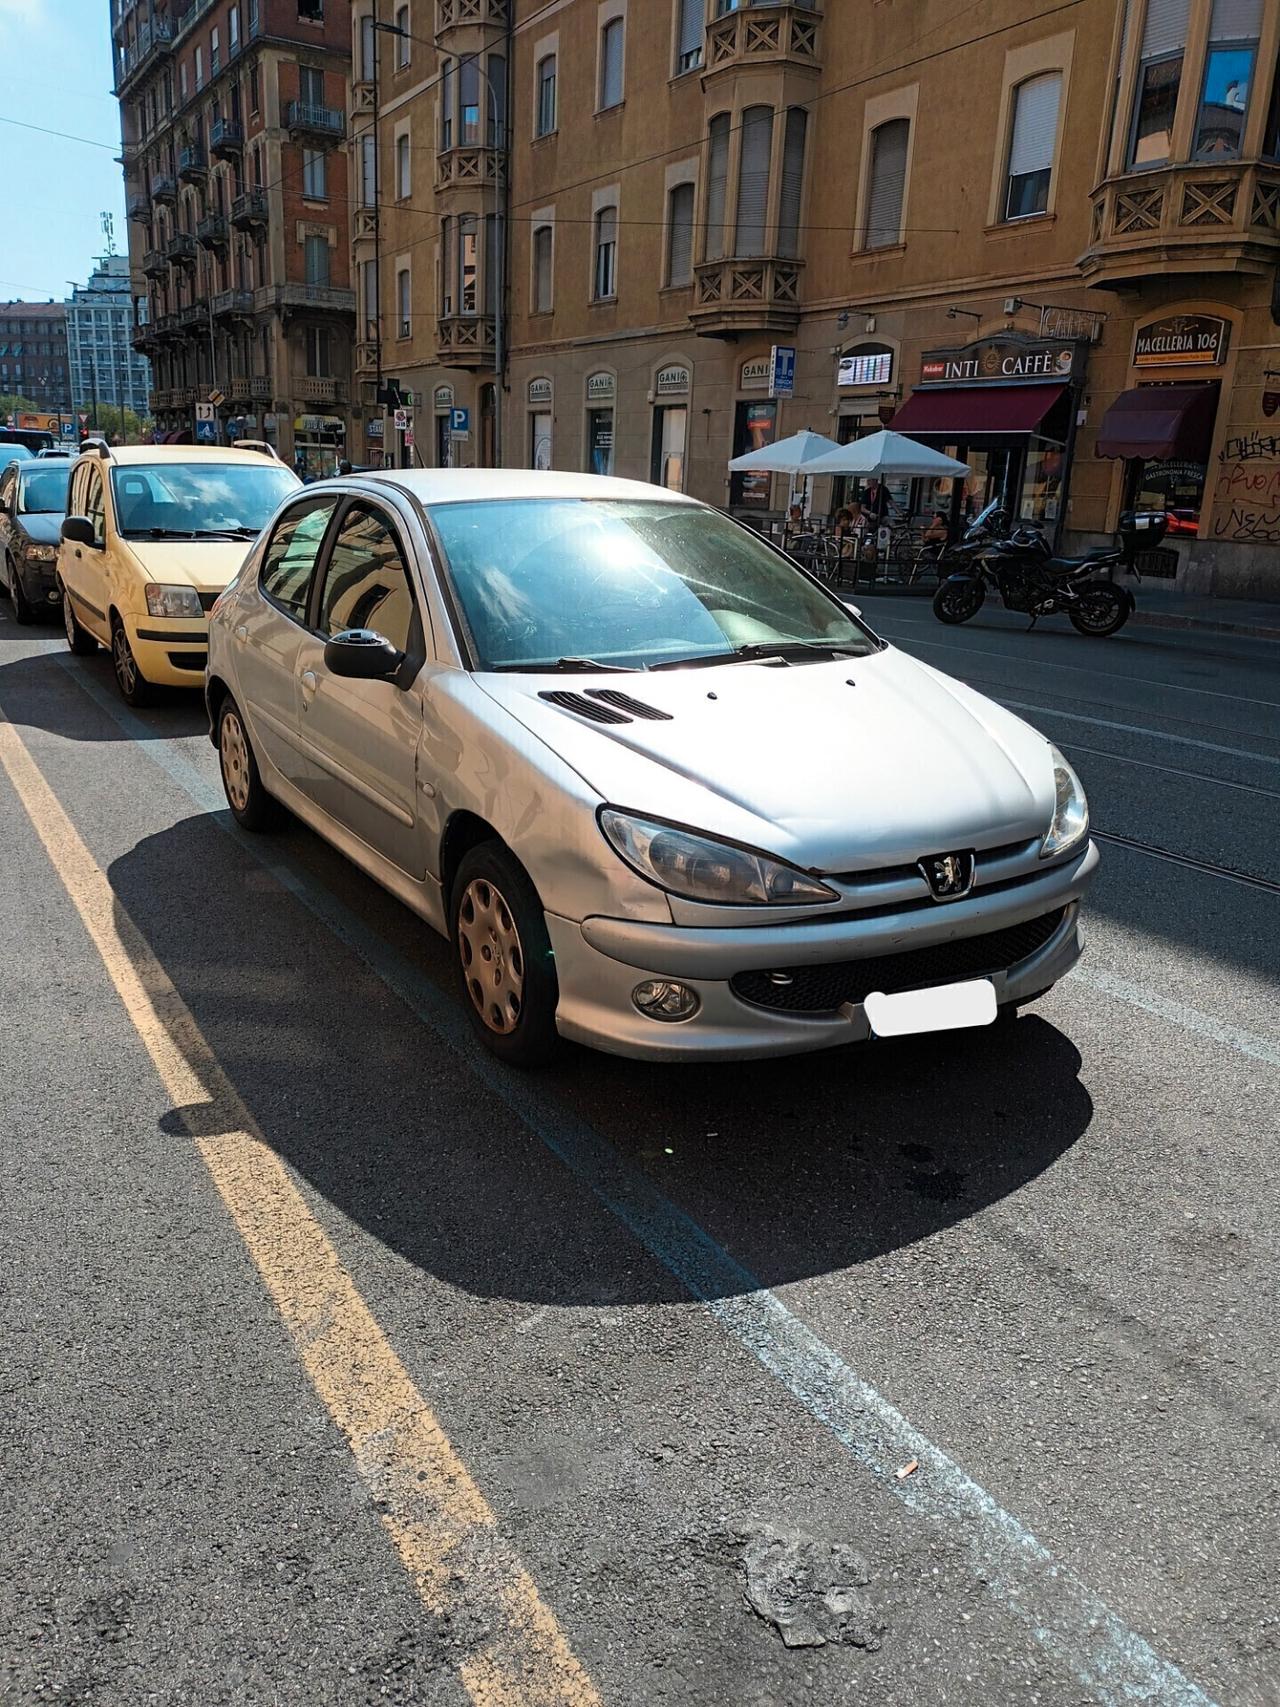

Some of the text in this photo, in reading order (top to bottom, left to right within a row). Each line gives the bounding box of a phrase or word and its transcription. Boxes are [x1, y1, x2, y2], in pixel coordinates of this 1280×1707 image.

[1136, 333, 1217, 353] MACELLERIA 106
[945, 351, 1051, 378] INTI CAFFÈ
[64, 423, 72, 433] P
[454, 410, 465, 428] P
